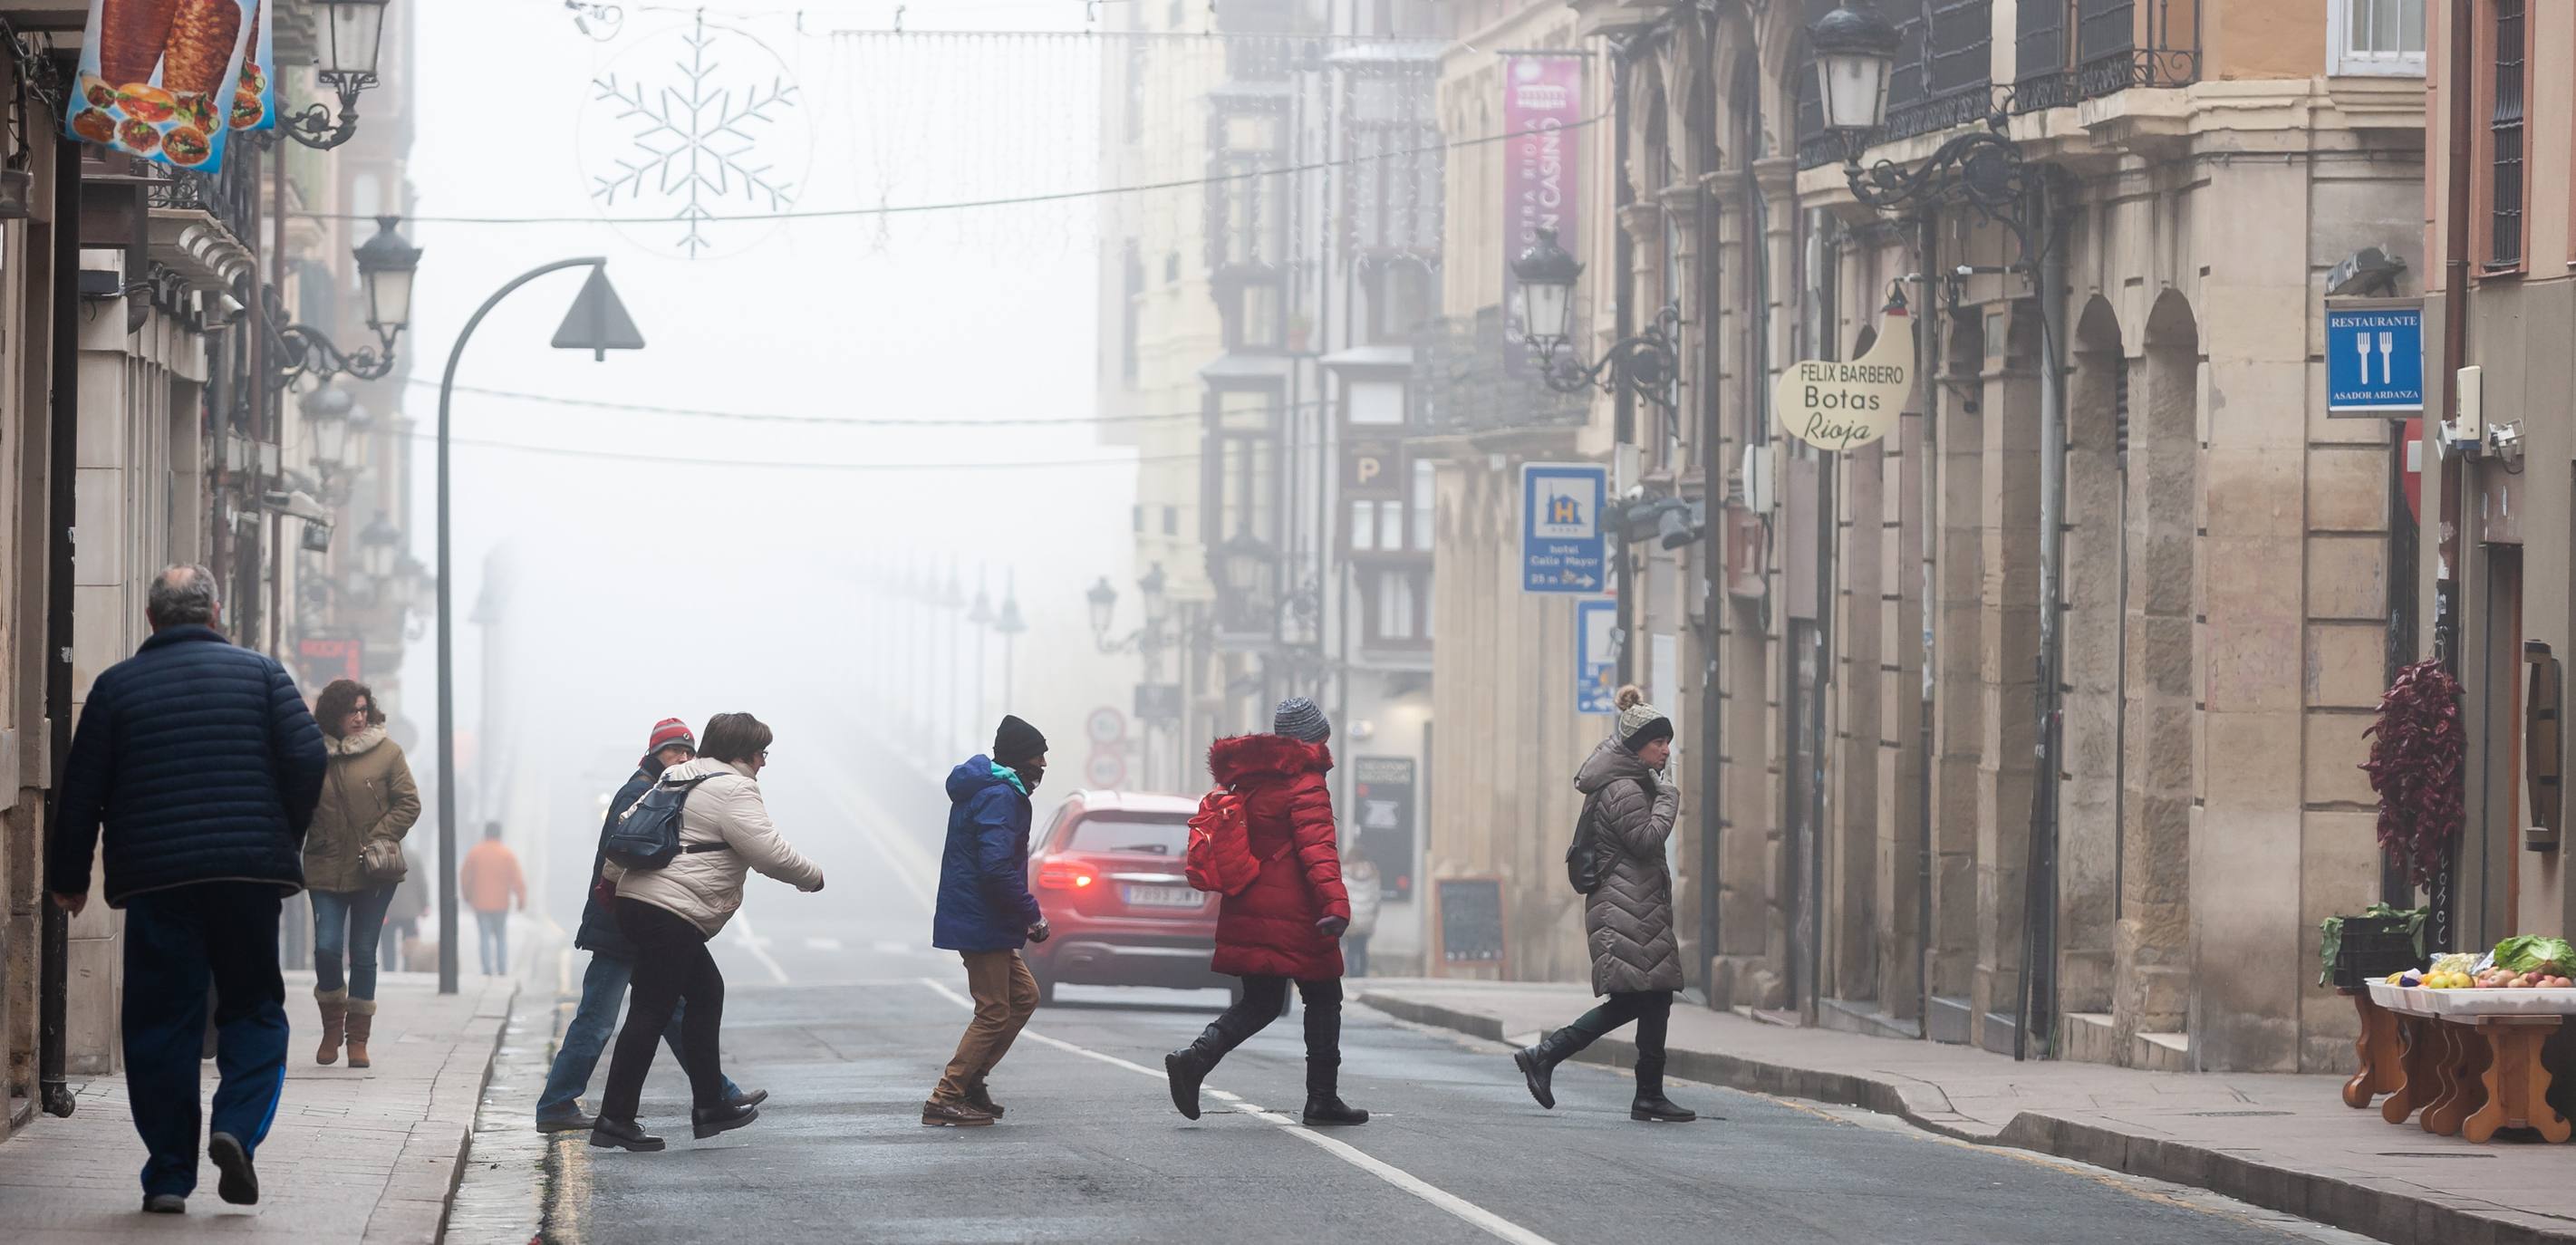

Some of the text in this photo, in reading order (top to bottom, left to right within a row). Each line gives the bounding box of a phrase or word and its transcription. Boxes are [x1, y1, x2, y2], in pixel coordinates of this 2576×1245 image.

[1539, 117, 1562, 208] CASINO
[2331, 316, 2417, 327] RESTAURANTE
[1800, 363, 1904, 384] FELIX BARBERO
[1805, 385, 1880, 410] Botas
[2334, 391, 2418, 400] ASADOR ARDANZA
[1804, 411, 1870, 449] Rioja
[1357, 457, 1381, 483] P
[1554, 499, 1575, 523] H
[1549, 544, 1579, 554] hotel
[1566, 556, 1598, 567] Mayor
